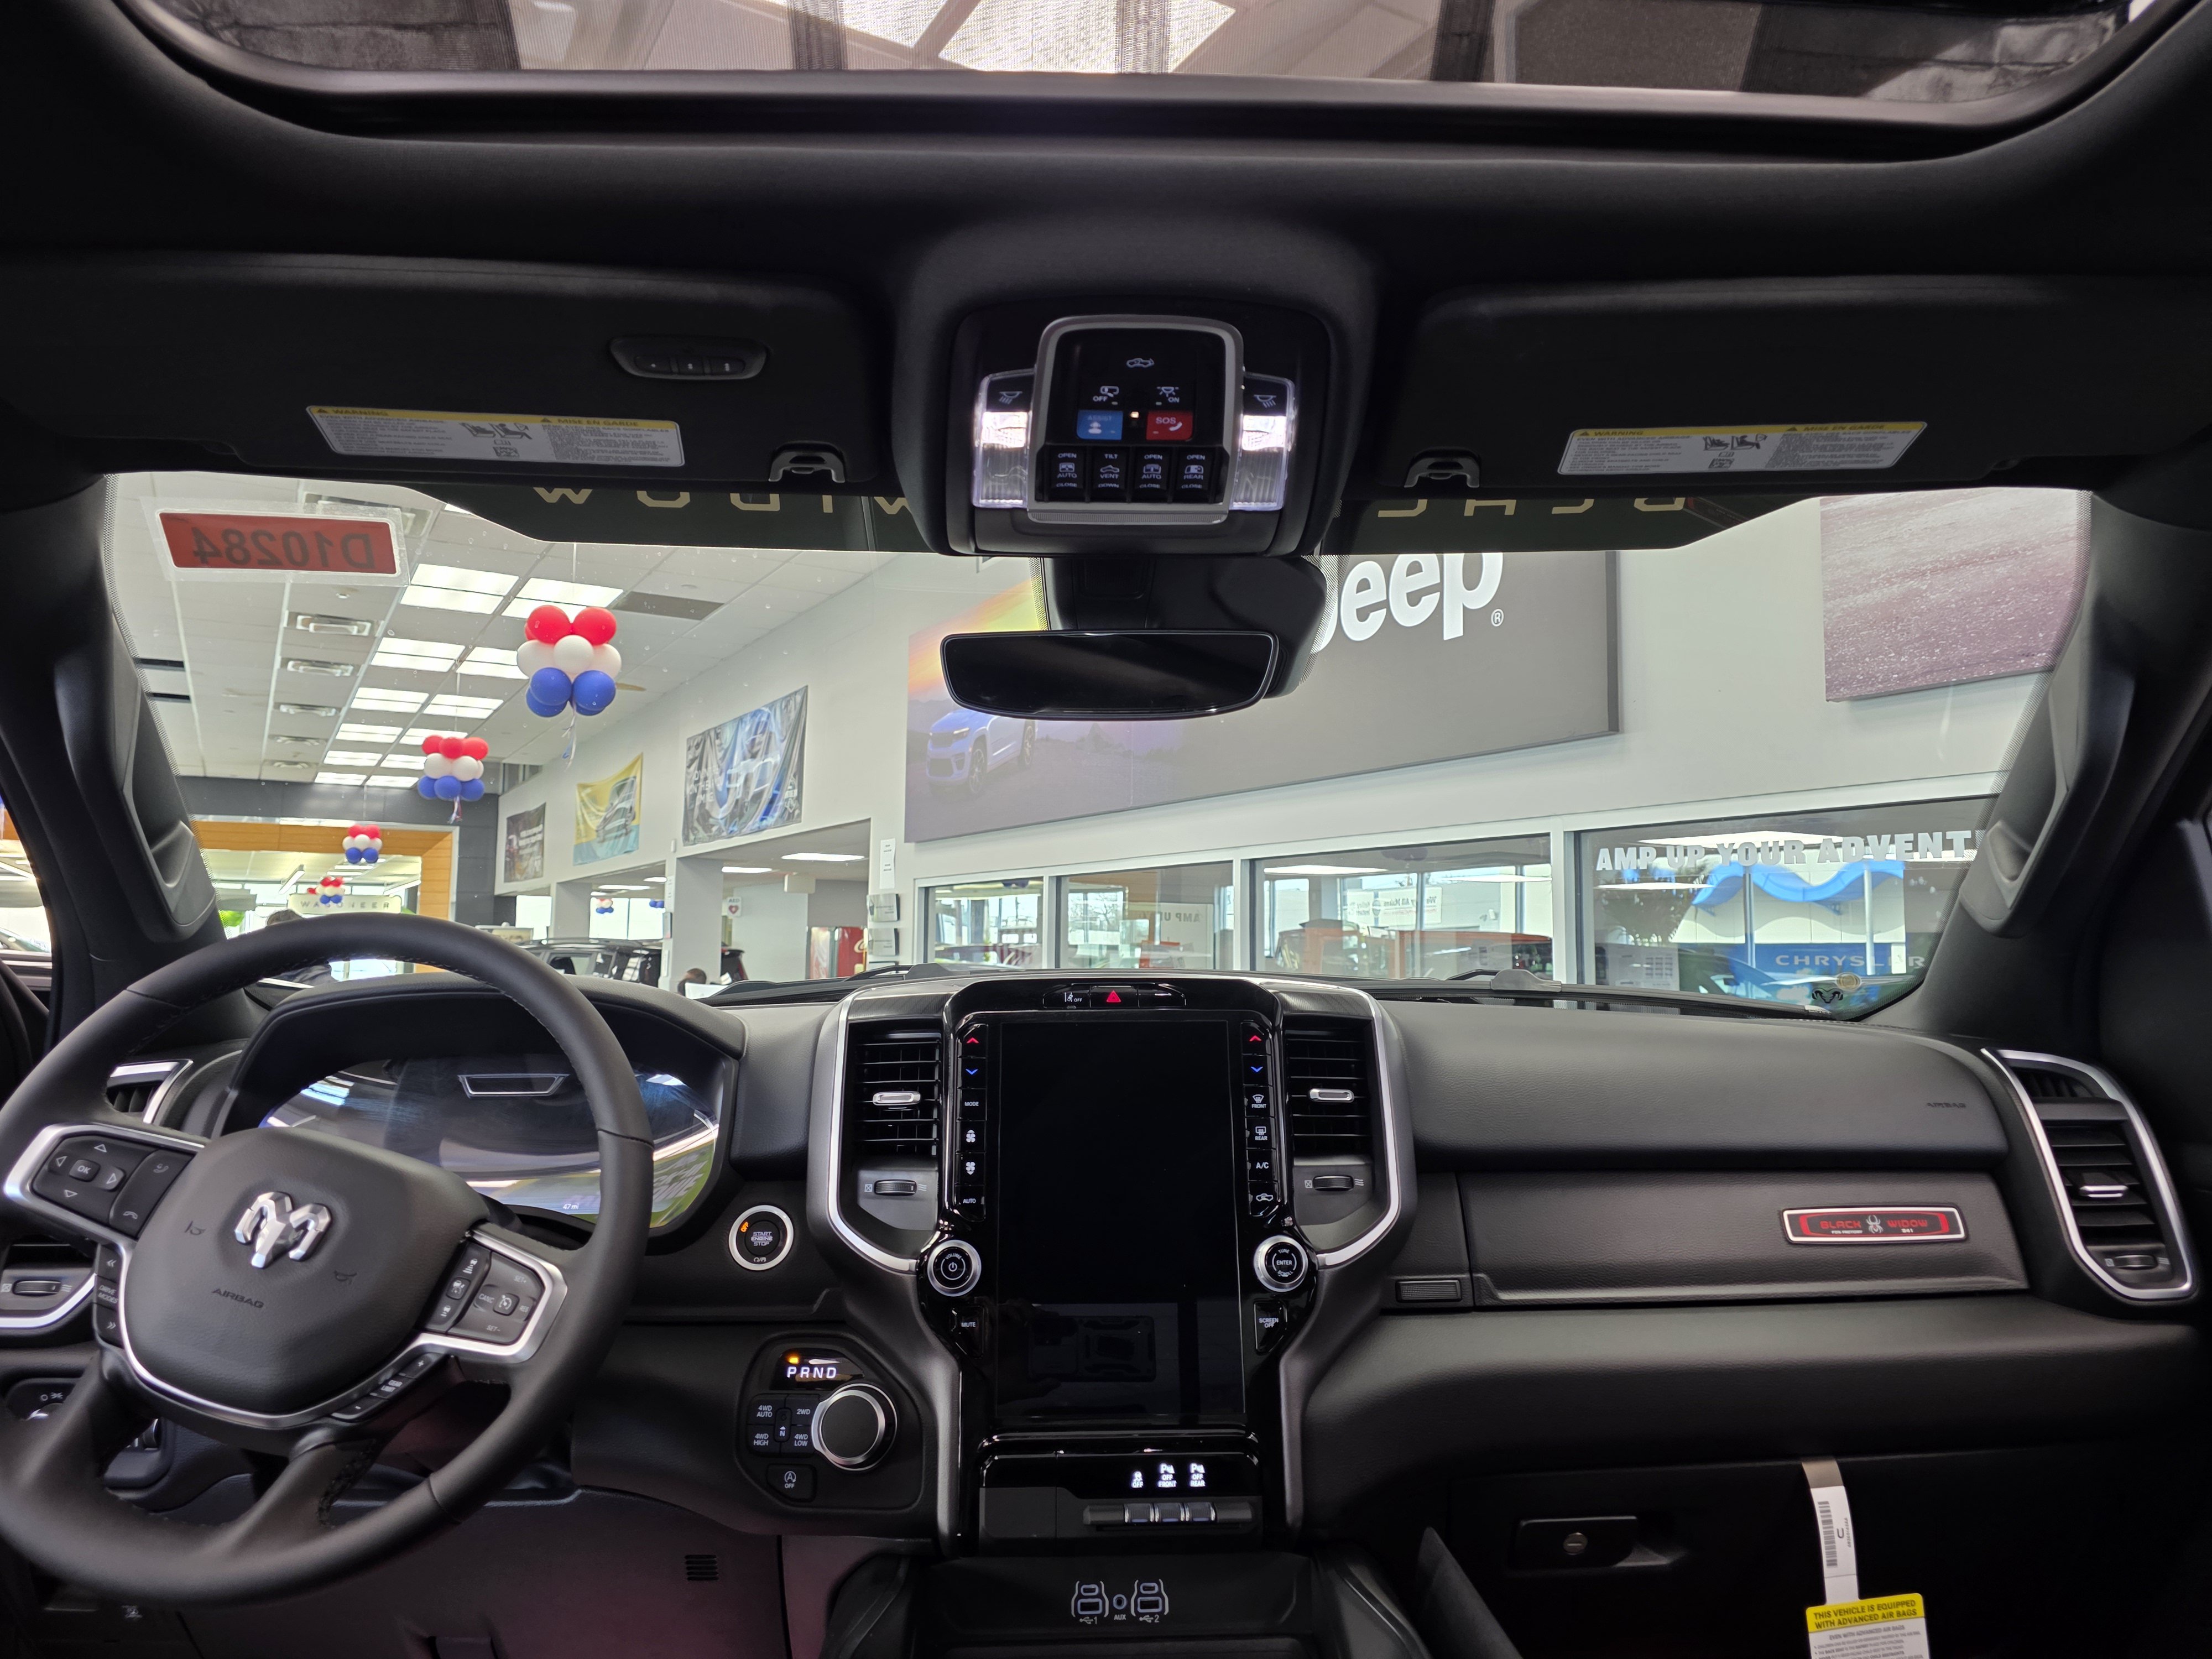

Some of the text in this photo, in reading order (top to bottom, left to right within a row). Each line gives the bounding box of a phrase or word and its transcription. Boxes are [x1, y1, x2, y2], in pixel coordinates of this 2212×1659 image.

[332, 408, 389, 416] WARNING
[1314, 552, 1504, 653] eep
[1596, 846, 1657, 871] AMP
[1666, 844, 1705, 869] UP
[1716, 839, 1807, 867] YOUR
[1775, 954, 1925, 967] CHRYSLR
[77, 1165, 90, 1175] OK
[1819, 1219, 1928, 1229] BLACK WIDOW
[99, 1285, 117, 1296] DRIVE
[98, 1292, 118, 1304] MODES
[212, 1288, 264, 1309] AIRBAG
[1813, 1611, 1832, 1620] THIS
[1833, 1606, 1866, 1616] VEHICLE
[1877, 1599, 1916, 1611] EQUIPPED
[1094, 1616, 1098, 1625] 1
[1154, 1614, 1160, 1623] 2
[1815, 1620, 1835, 1630] WITH
[1838, 1614, 1880, 1626] ADVANCED
[1897, 1609, 1917, 1618] BAGS
